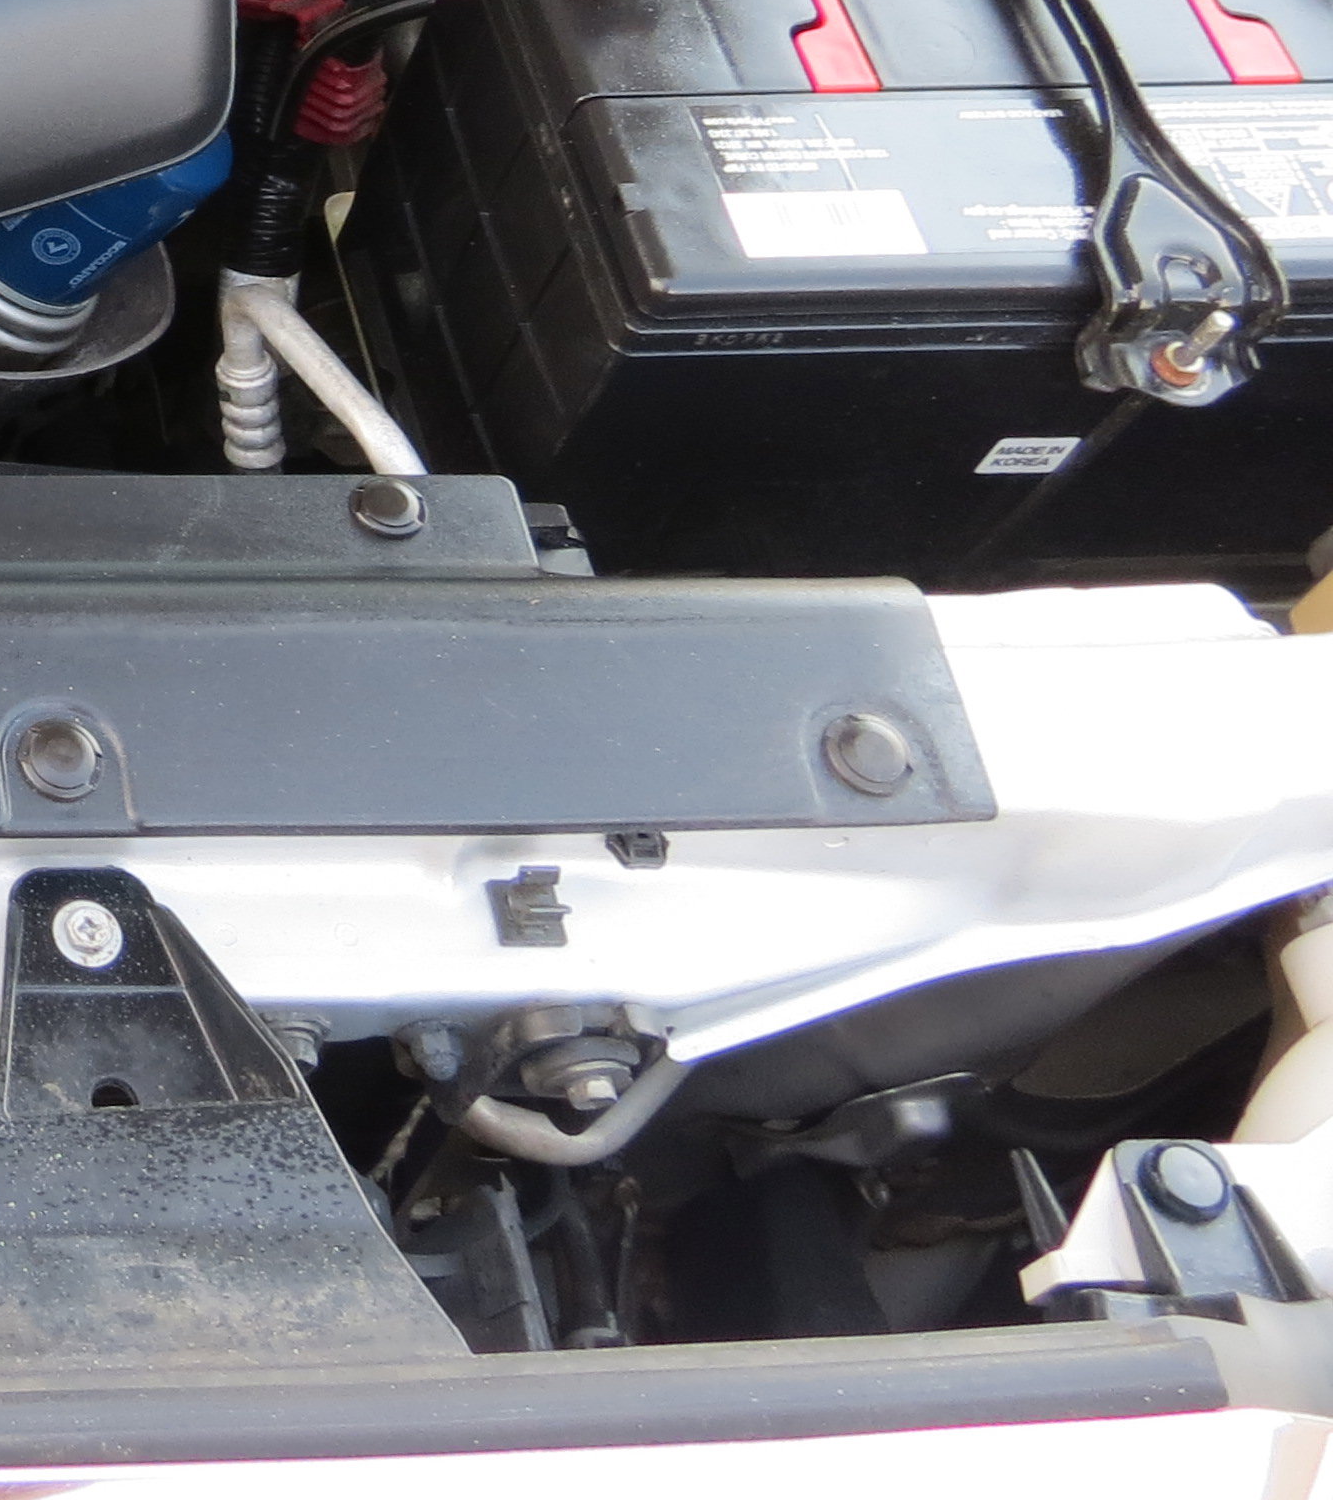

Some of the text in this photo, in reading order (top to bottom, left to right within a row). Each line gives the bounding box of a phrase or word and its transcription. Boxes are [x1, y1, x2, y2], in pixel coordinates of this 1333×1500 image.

[994, 446, 1067, 455] MADE IN
[990, 457, 1050, 467] KOREA
